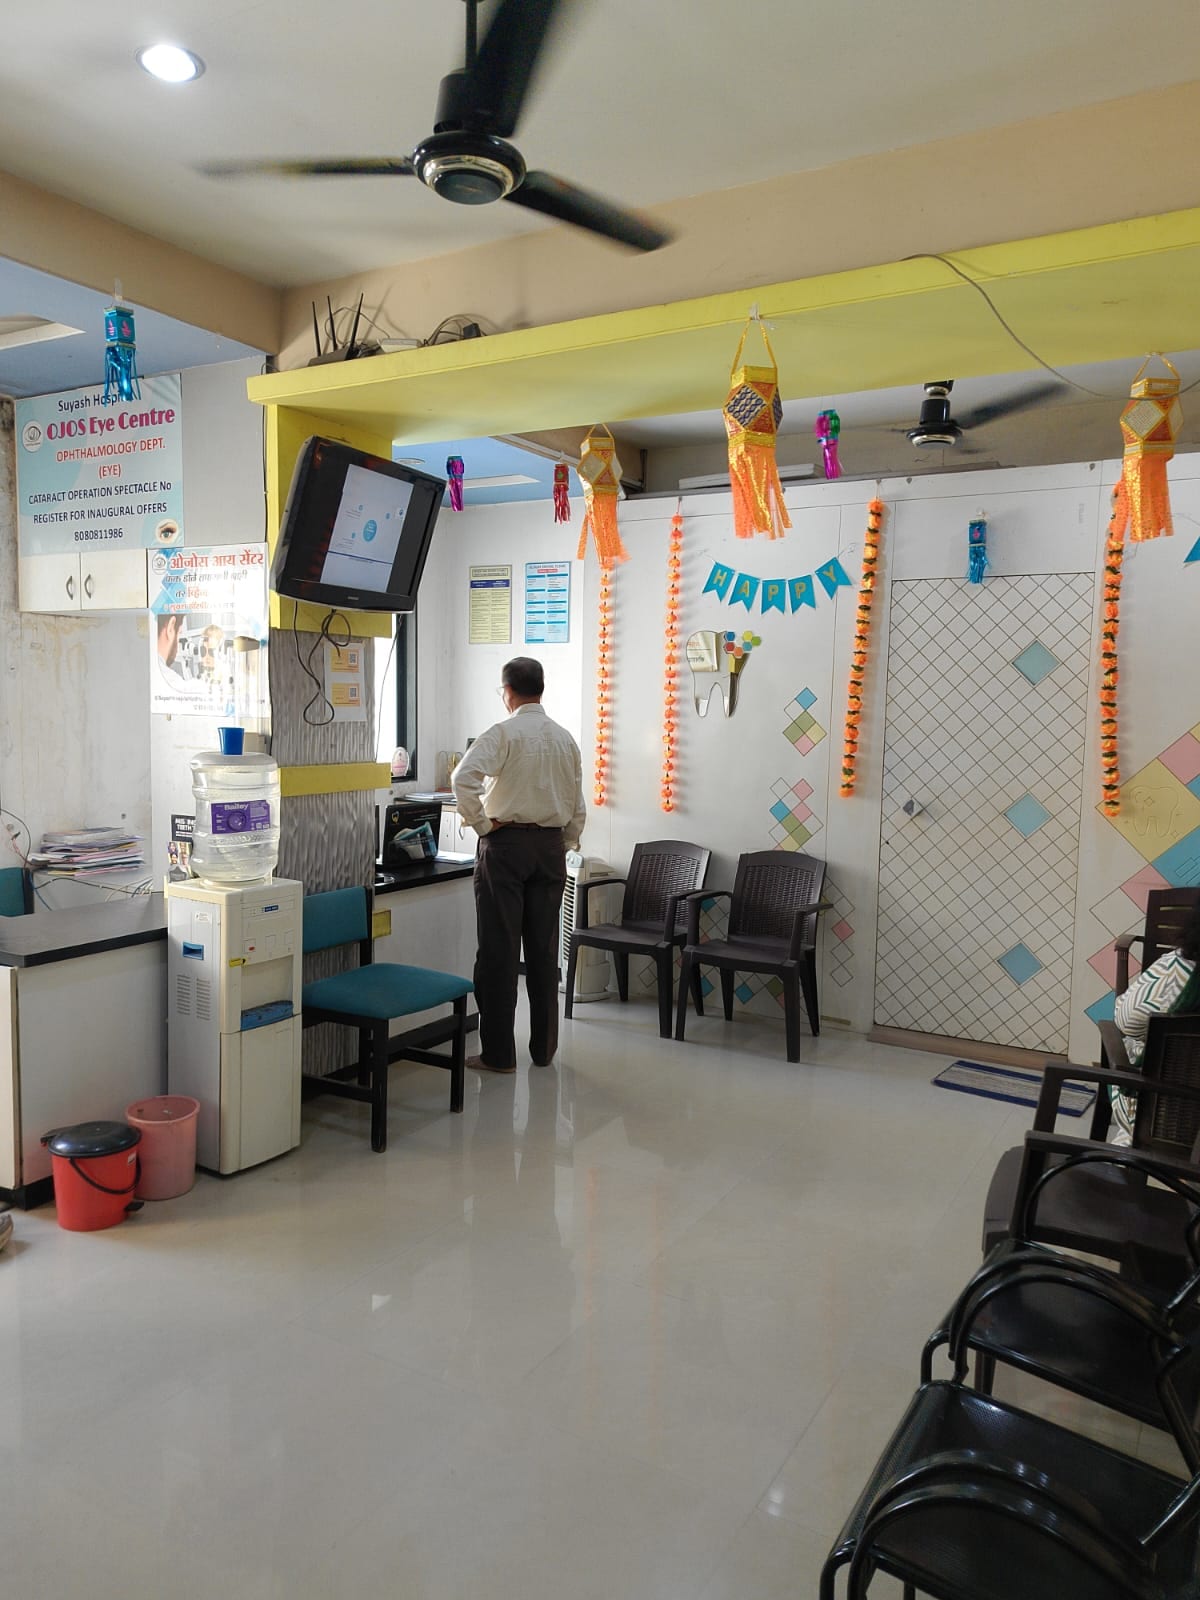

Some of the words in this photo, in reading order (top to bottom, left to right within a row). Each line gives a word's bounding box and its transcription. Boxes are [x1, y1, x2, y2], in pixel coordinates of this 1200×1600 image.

[58, 395, 91, 413] Suyash
[94, 388, 131, 406] Hospi
[47, 418, 87, 440] OJOS
[90, 416, 115, 437] Eye
[118, 408, 175, 430] Centre
[56, 440, 138, 462] OPHTHALMOLOGY
[140, 437, 166, 452] DEPT.
[98, 463, 122, 479] (EYE)
[28, 491, 69, 505] CATARACT
[68, 486, 113, 501] OPERATION
[114, 481, 158, 496] SPECTACLE
[159, 480, 172, 491] No
[33, 511, 68, 524] REGISTER
[70, 510, 86, 521] FOR
[87, 505, 135, 519] INAUGURAL
[137, 502, 167, 514] OFFERS
[74, 528, 124, 541] 8080811986
[239, 549, 264, 566] सेंटर
[713, 565, 837, 602] HAPPY
